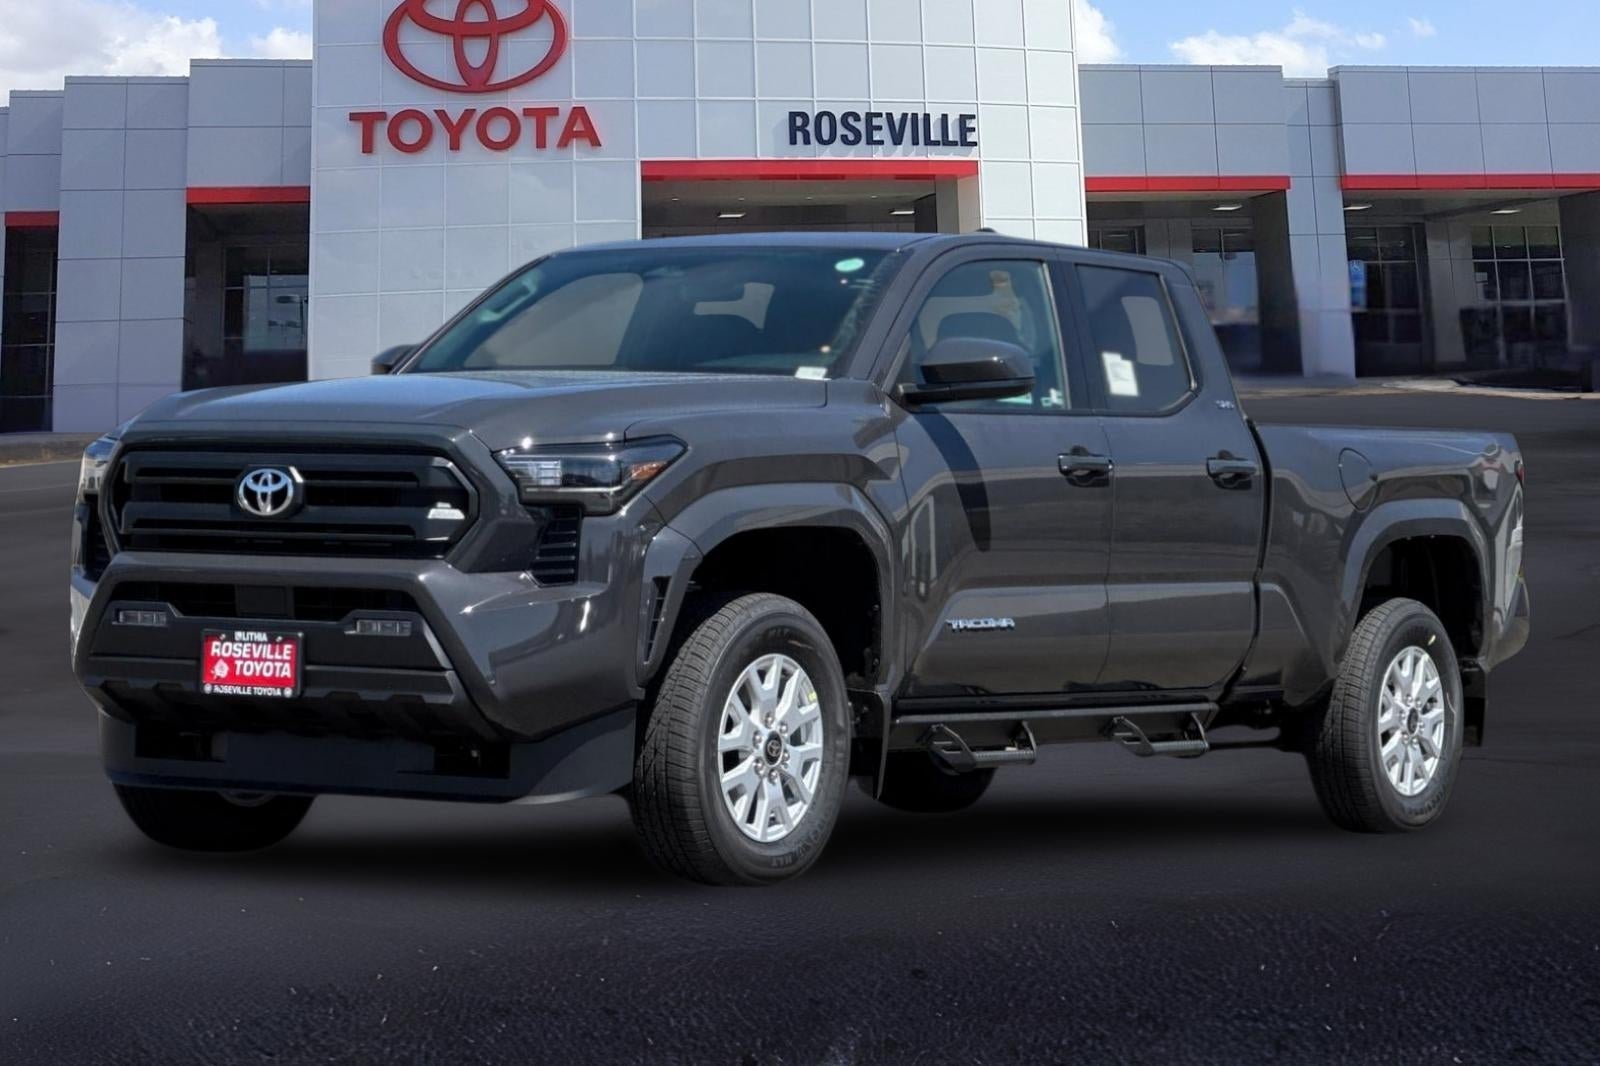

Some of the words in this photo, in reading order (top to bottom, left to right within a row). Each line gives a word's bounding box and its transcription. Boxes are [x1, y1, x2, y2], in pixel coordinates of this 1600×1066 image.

[349, 106, 602, 154] TOYOTA
[788, 110, 978, 147] ROSEVILLE
[210, 640, 293, 660] ROSEVILLE
[234, 660, 292, 678] TOYOTA
[213, 684, 252, 695] ROSEVILLE
[253, 686, 282, 697] TOYOTA
